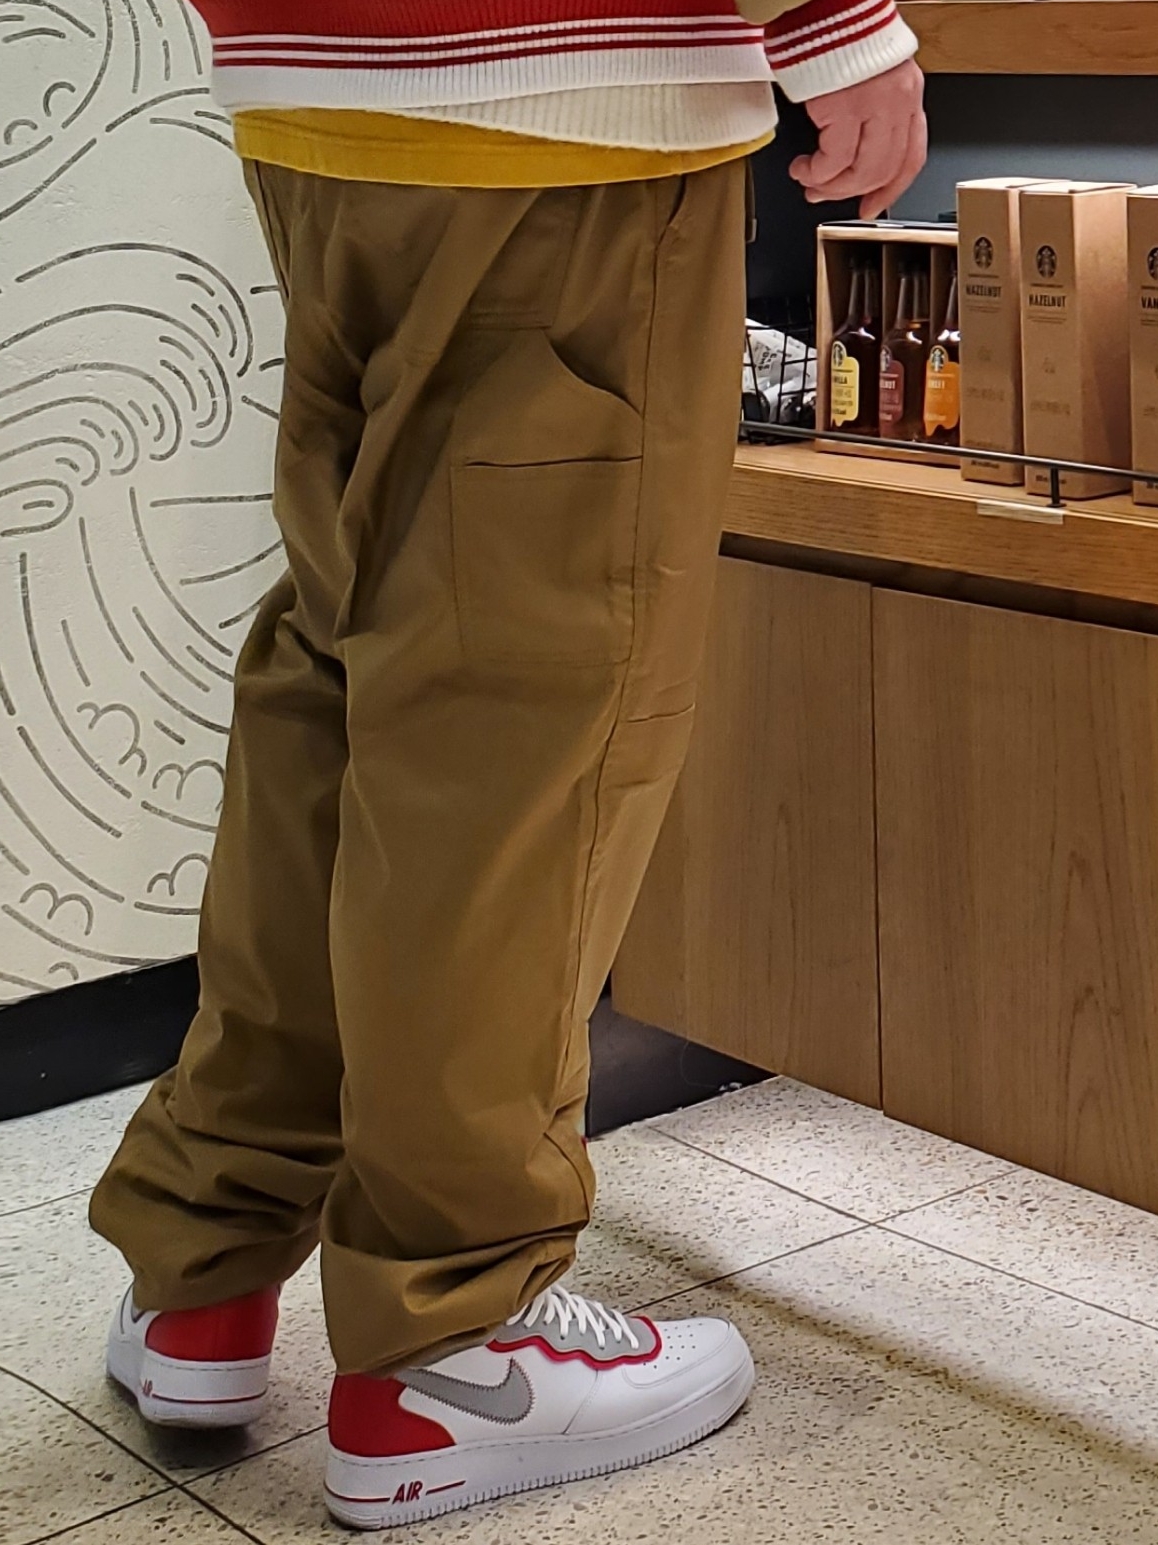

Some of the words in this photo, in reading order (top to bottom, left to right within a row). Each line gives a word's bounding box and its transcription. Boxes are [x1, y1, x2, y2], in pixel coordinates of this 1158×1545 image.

[965, 284, 1002, 298] HAZELNUT
[1028, 294, 1067, 308] HAZELNUT
[392, 1480, 424, 1505] AIR
